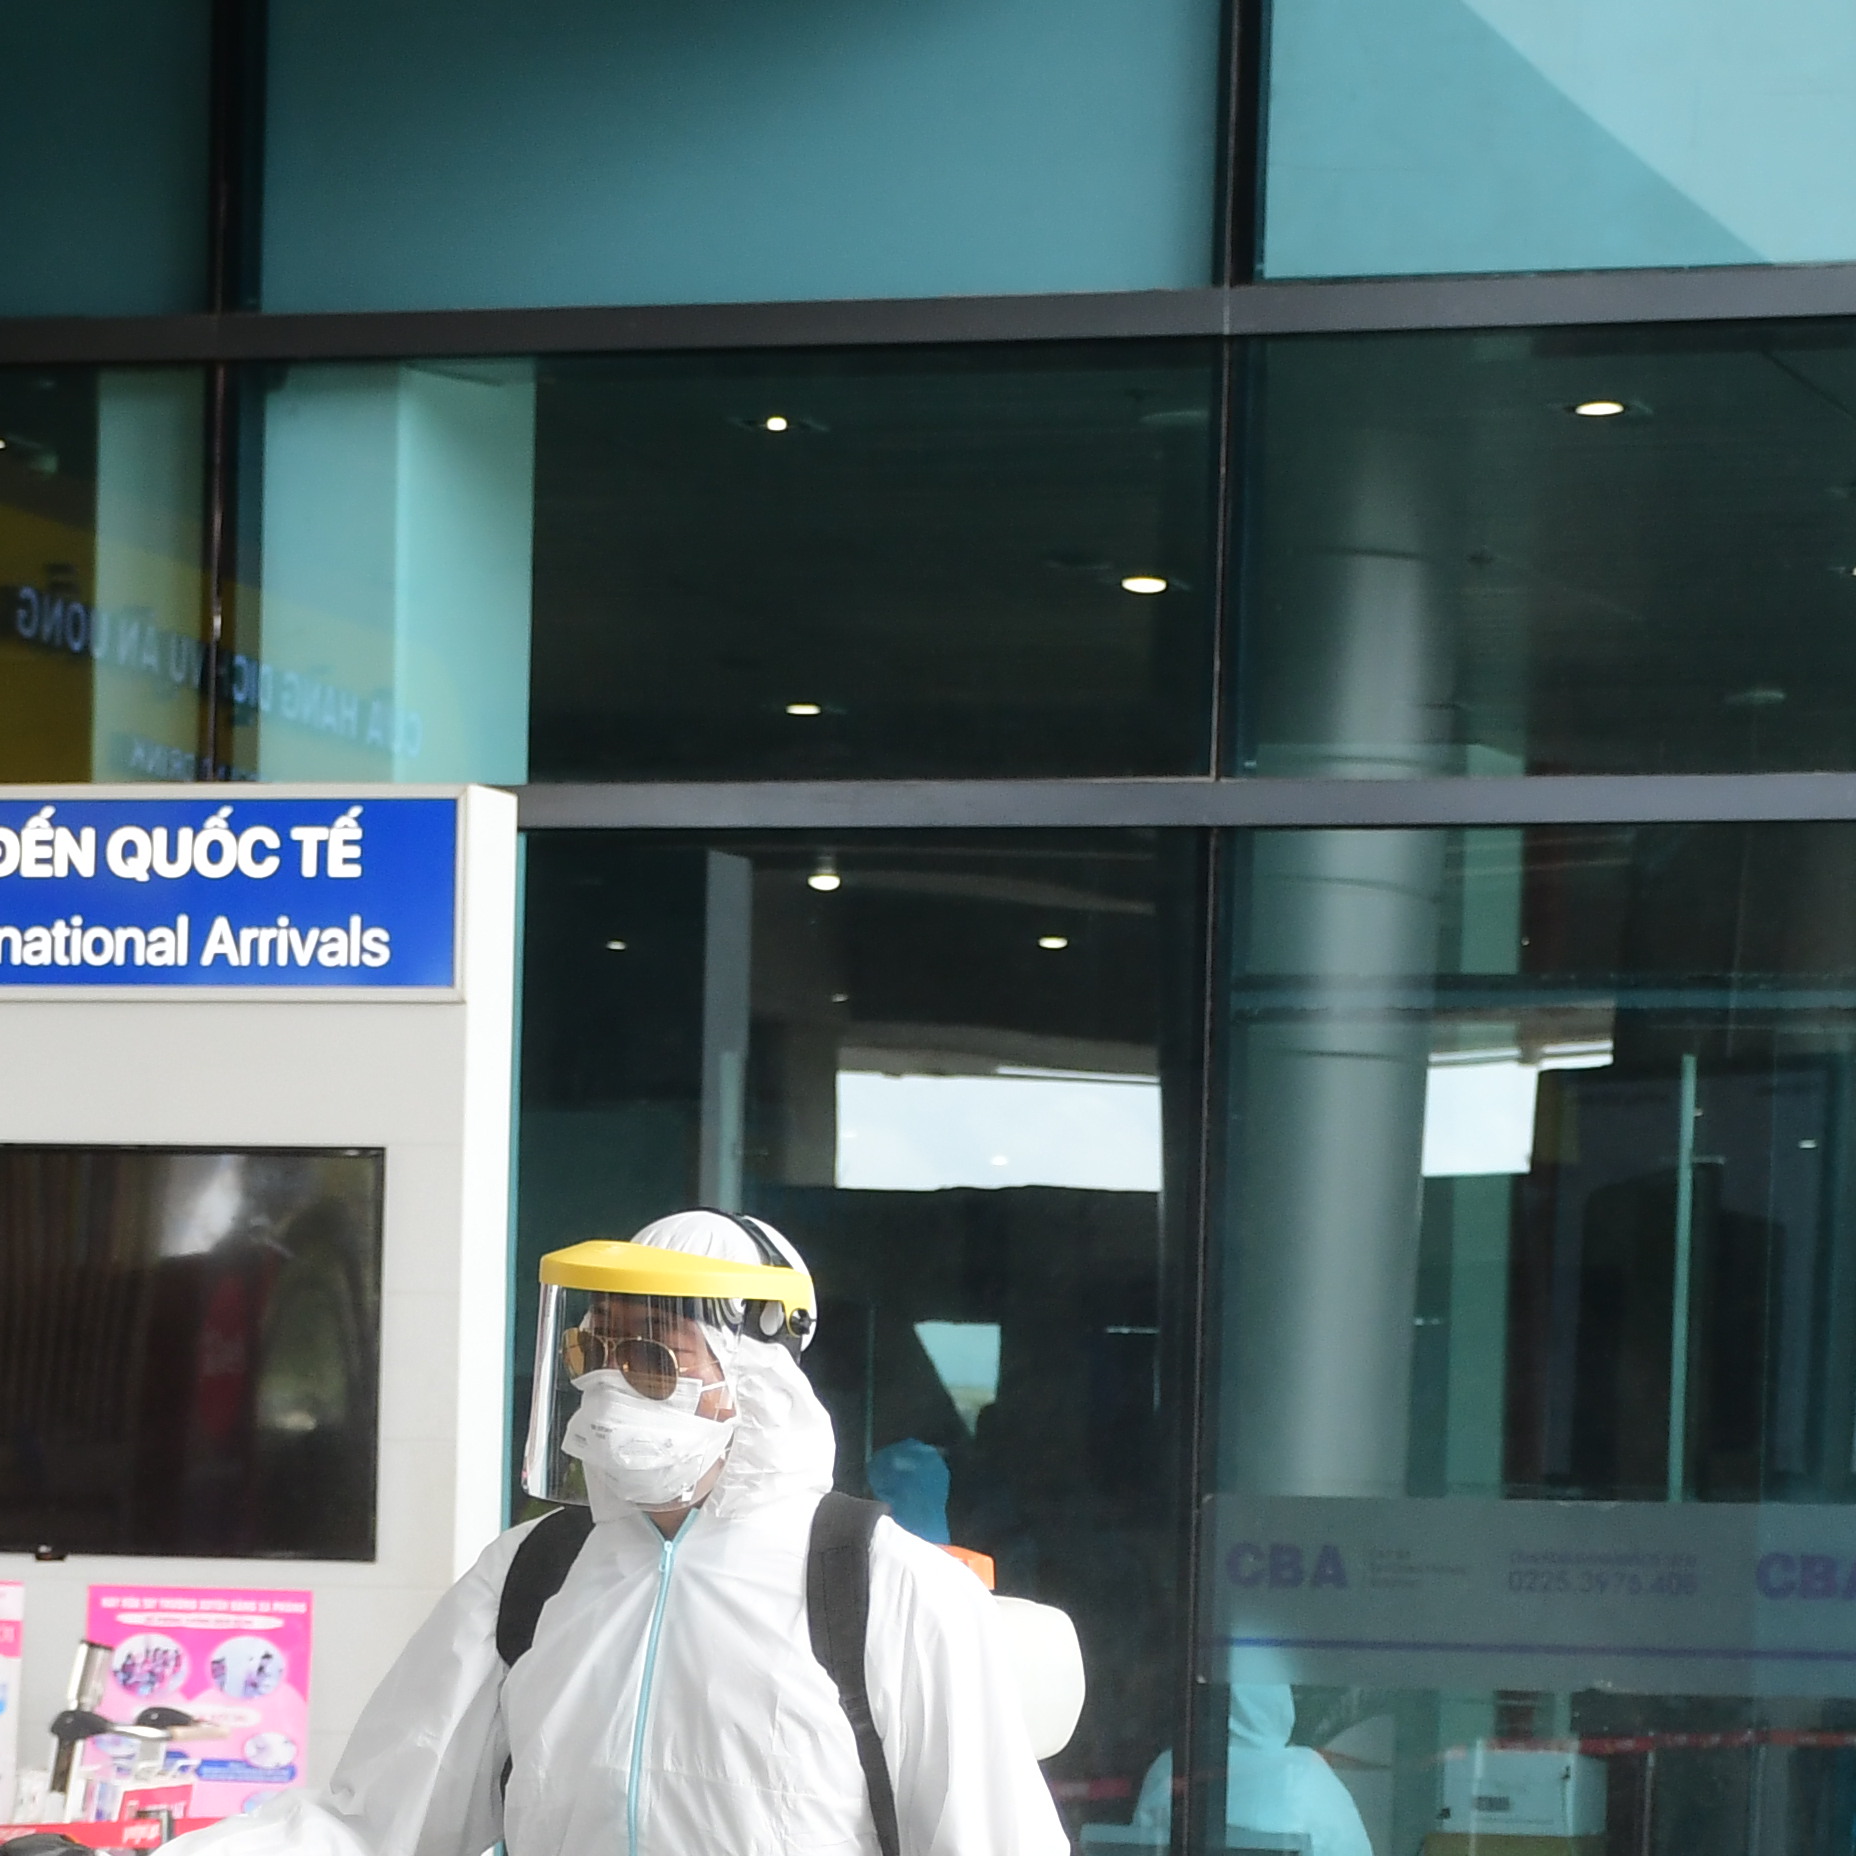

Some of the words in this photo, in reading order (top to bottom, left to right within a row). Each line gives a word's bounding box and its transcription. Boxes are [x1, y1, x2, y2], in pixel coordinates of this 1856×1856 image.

[105, 806, 282, 883] QUỐC
[289, 806, 366, 879] TẾ
[199, 915, 392, 969] Arrivals
[1223, 1541, 1350, 1590] CBA
